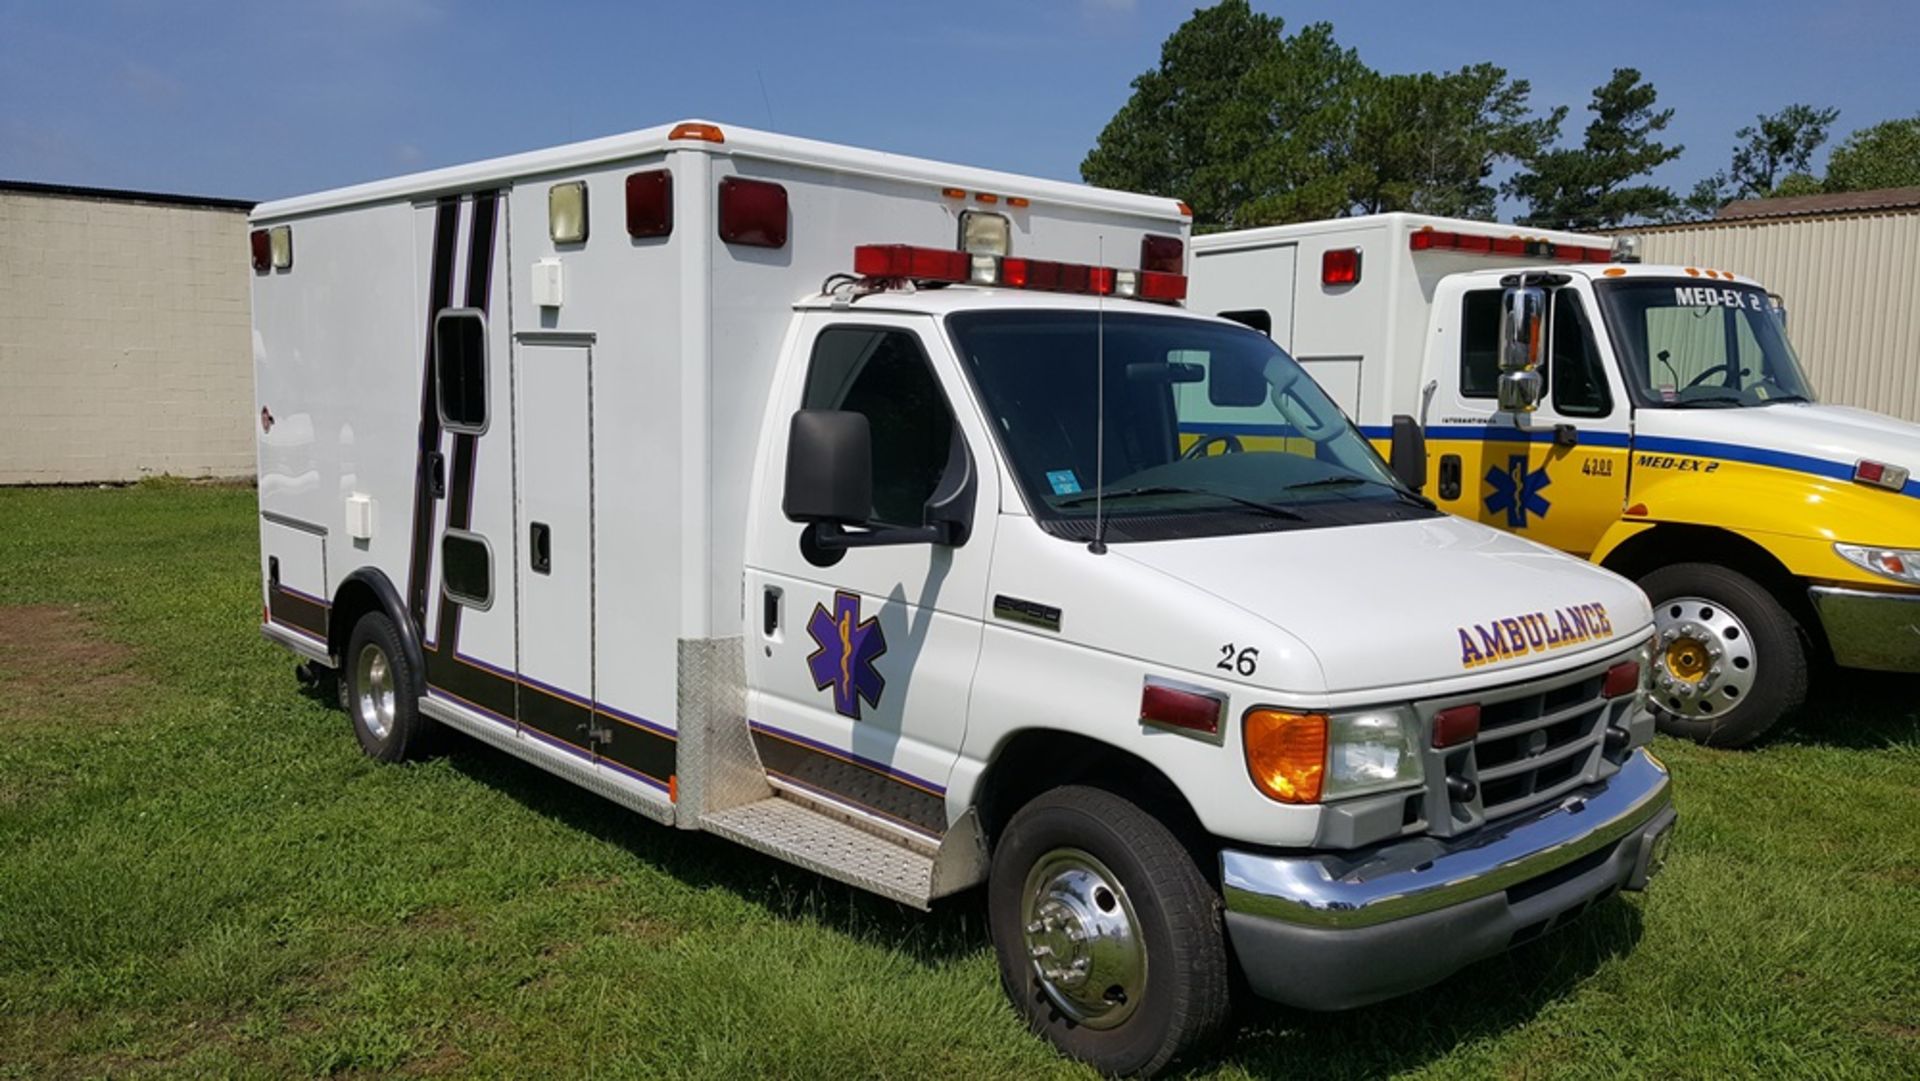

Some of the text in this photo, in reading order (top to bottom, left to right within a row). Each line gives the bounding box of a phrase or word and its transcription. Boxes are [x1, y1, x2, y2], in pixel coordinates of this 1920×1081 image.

[1674, 287, 1762, 311] MED-EX 2
[1637, 455, 1720, 473] MED-EX 2
[1457, 602, 1613, 668] AMBULANCE
[1217, 642, 1260, 677] 26
